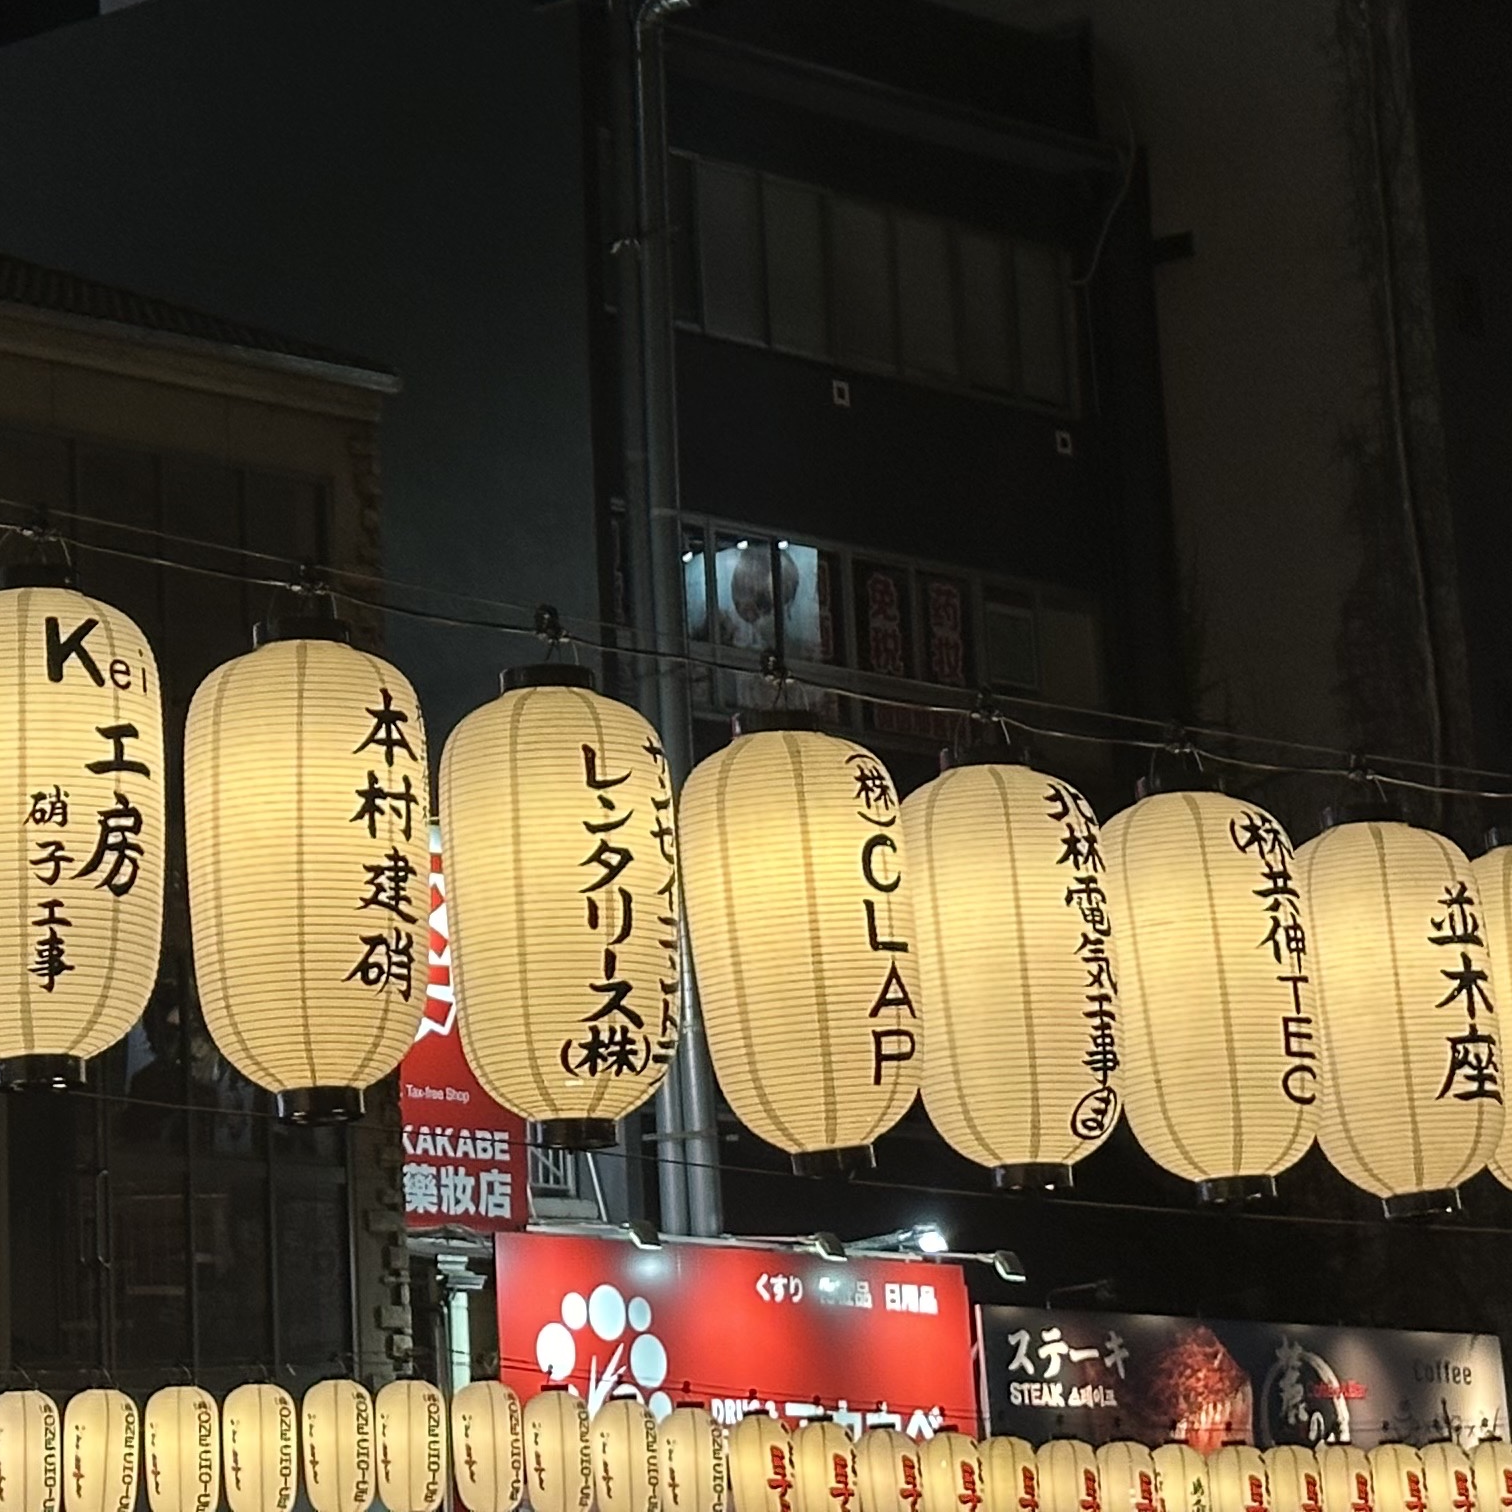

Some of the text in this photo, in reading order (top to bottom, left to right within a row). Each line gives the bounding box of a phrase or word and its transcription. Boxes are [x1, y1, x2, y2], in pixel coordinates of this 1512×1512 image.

[24, 785, 76, 993] 硝子工事
[68, 724, 150, 897] 工房
[342, 687, 419, 1002] 本村建硝
[1428, 882, 1502, 1105] 並木座
[755, 1273, 803, 1303] くすり
[1007, 1327, 1130, 1380] ステーキ
[1010, 1382, 1066, 1408] STEAK
